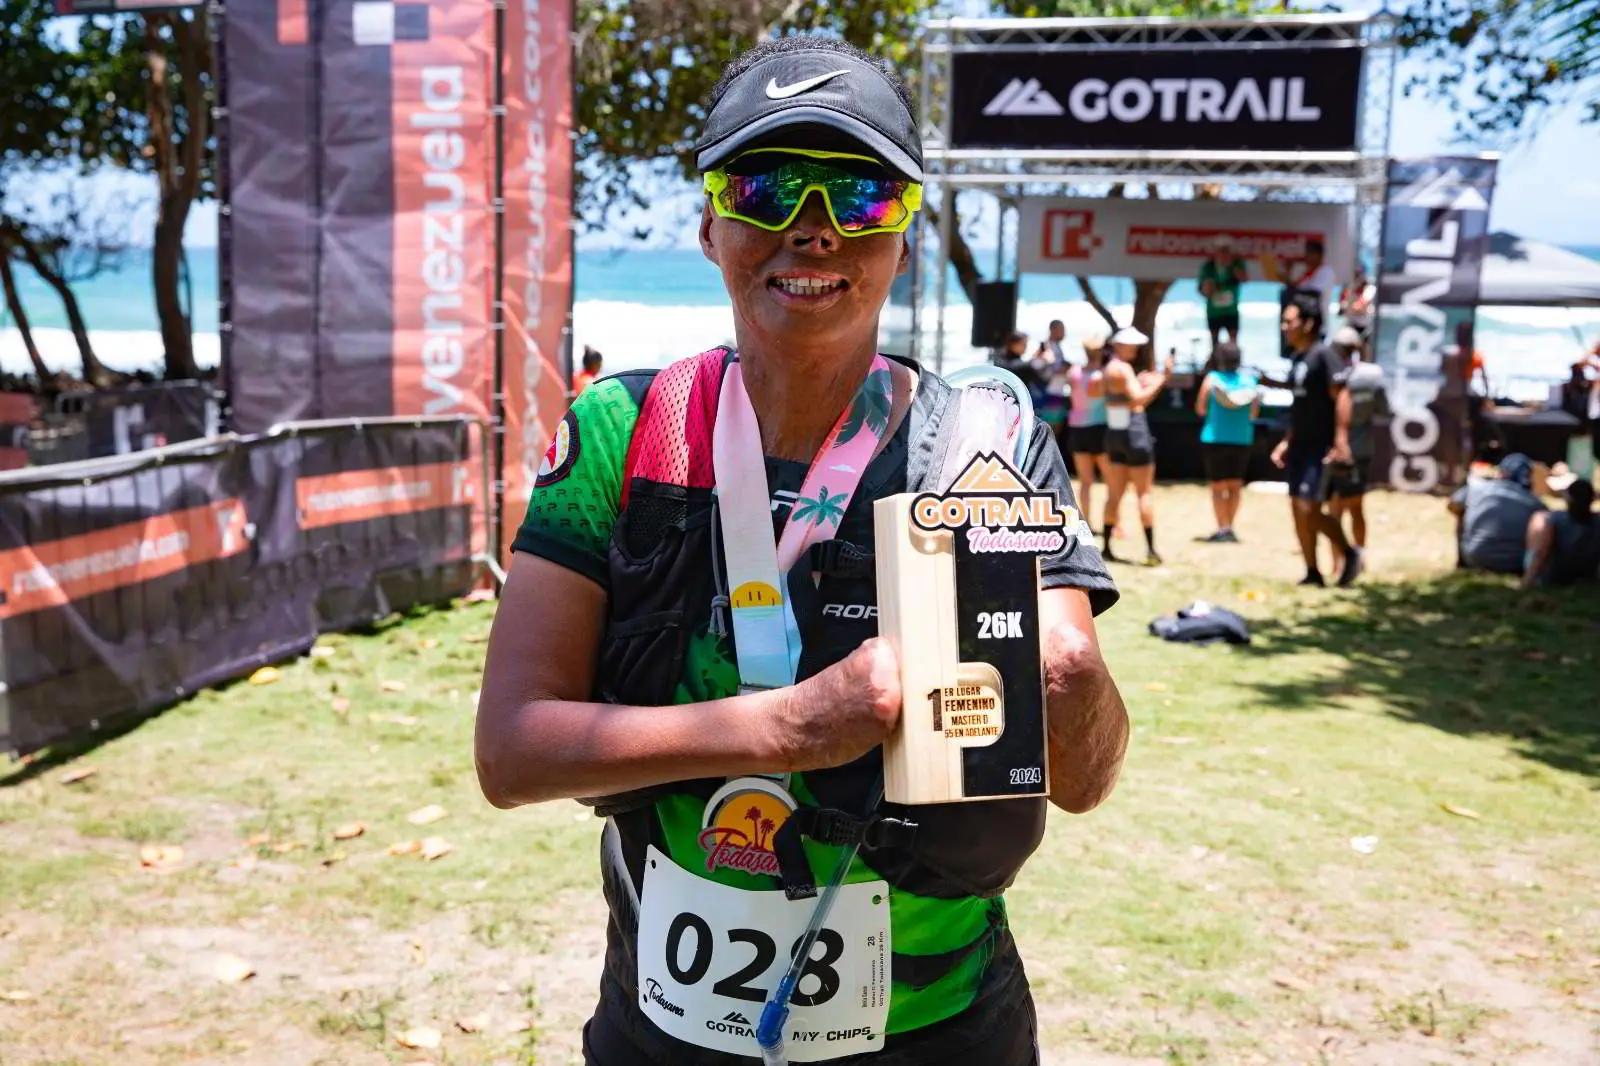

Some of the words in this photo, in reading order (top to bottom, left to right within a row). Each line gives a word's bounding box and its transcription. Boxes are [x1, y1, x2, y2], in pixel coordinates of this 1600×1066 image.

[1068, 77, 1321, 122] GOTRAIL
[410, 65, 464, 418] venezuela
[1389, 220, 1459, 492] GOTRAIL
[915, 497, 1062, 527] GOTRAIL
[968, 528, 1063, 552] Todasana
[823, 604, 878, 619] ROP
[977, 612, 1023, 638] 26K
[957, 687, 980, 696] LUGAR
[945, 698, 995, 711] FEMENINO
[951, 715, 981, 725] MASTER
[945, 729, 953, 738] 55
[955, 728, 963, 737] EN
[966, 727, 998, 736] ADELANTE
[1010, 768, 1041, 784] 2024
[700, 828, 783, 874] Todasa
[868, 936, 875, 946] 28
[666, 912, 844, 1007] 028
[646, 978, 685, 1017] Todasana
[706, 1020, 756, 1038] GOTRA
